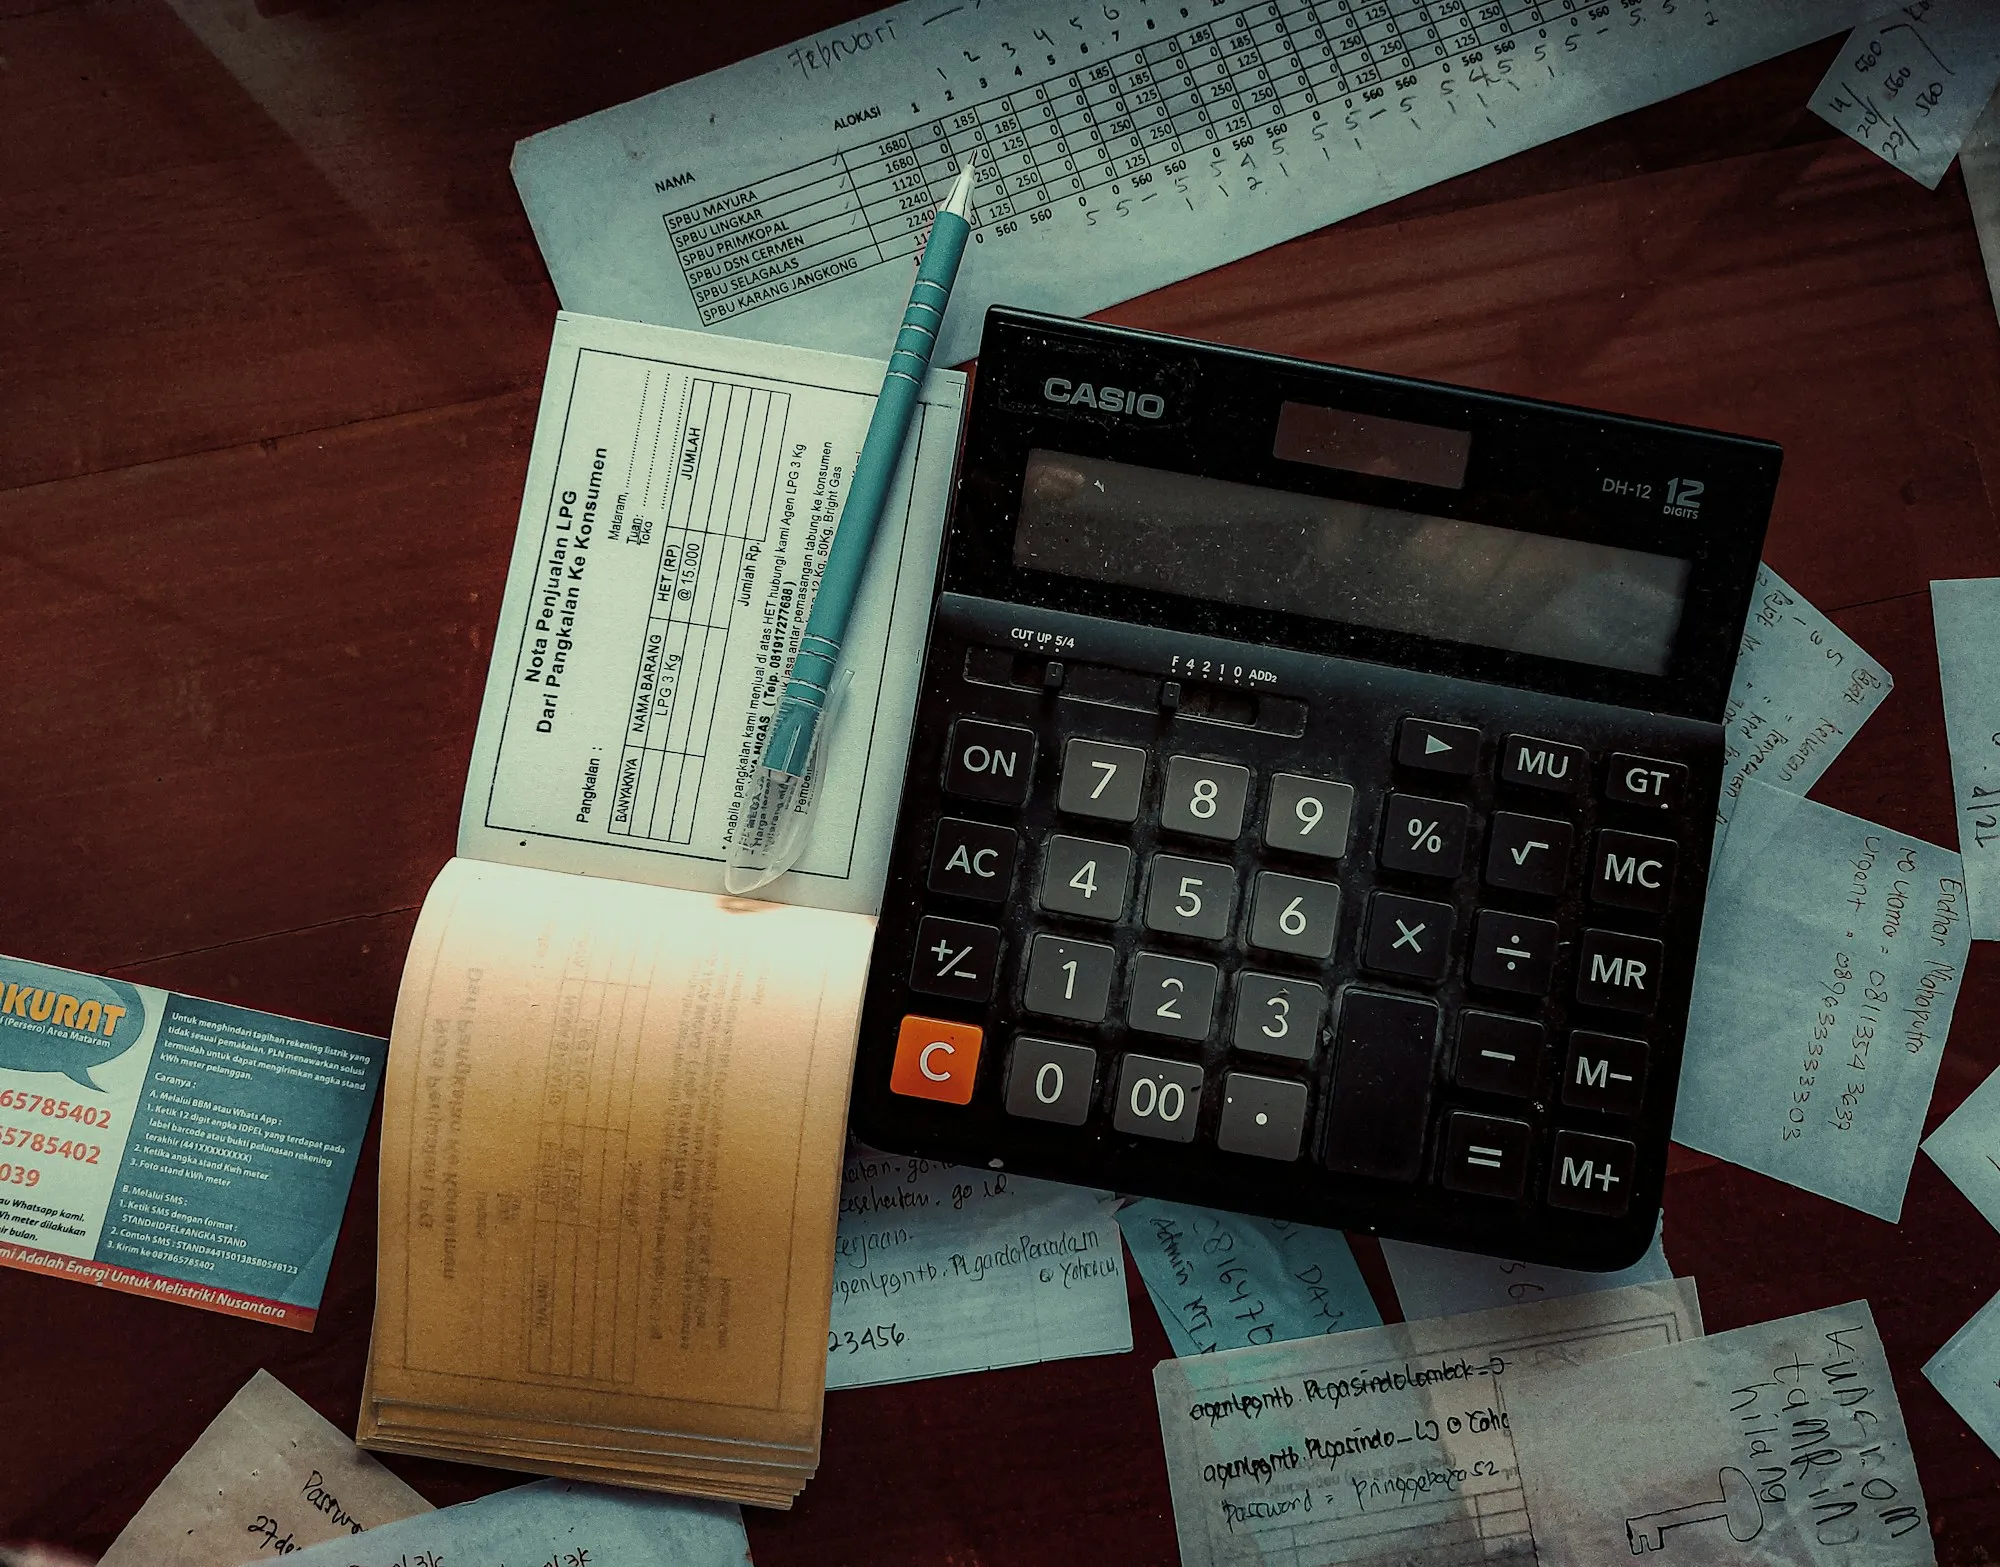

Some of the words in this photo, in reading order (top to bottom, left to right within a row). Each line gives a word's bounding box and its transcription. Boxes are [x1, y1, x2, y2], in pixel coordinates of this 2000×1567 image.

[834, 105, 881, 131] ALOKASI
[953, 112, 975, 129] 185
[654, 171, 696, 193] NAMA
[668, 209, 701, 230] SPBU
[701, 190, 758, 218] MAYURA
[878, 137, 907, 156] 1680
[675, 227, 708, 248] SPBU
[709, 208, 764, 235] LINGKAR
[885, 155, 914, 174] 1680
[682, 245, 715, 266] SPBU
[716, 220, 790, 254] PRIMKOPAL
[891, 173, 921, 192] 1120
[689, 264, 721, 285] SPBU
[723, 253, 750, 272] DSN
[751, 234, 805, 262] CERMEN
[898, 191, 928, 210] 2240
[995, 220, 1018, 237] 560
[1029, 208, 1052, 224] 560
[696, 282, 728, 303] SPBU
[730, 257, 799, 290] SELAGALAS
[905, 209, 935, 228] 2240
[703, 300, 736, 321] SPBU
[737, 281, 790, 309] KARANG
[791, 257, 858, 289] JANGKONG
[1043, 377, 1165, 419] CASIO
[680, 427, 701, 480] JUMLAH
[791, 443, 807, 458] Kg
[812, 441, 832, 496] konsumen
[785, 471, 799, 494] LPG
[828, 466, 842, 488] Gas
[1602, 478, 1652, 499] DH-12
[1666, 477, 1704, 509] 12
[555, 490, 577, 531] LPG
[573, 447, 607, 550] Konsumen
[607, 492, 629, 541] Mataram,
[780, 497, 795, 526] Agen
[810, 499, 822, 512] ke
[822, 490, 838, 523] Bright
[1662, 505, 1698, 519] DIGITS
[638, 521, 653, 545] Toko
[774, 527, 790, 553] kami
[803, 514, 822, 551] tabung
[816, 526, 834, 557] 50Kg,
[567, 556, 586, 580] Ke
[663, 544, 681, 572] (RP)
[680, 543, 700, 584] 15.000
[744, 542, 761, 561] Rp.
[535, 537, 568, 631] Penjualan
[656, 574, 672, 602] HET
[737, 565, 756, 607] Jumlah
[766, 555, 787, 599] hubungi
[793, 554, 813, 624] pemasangan
[762, 600, 776, 625] HET
[544, 587, 580, 687] Pangkalan
[759, 628, 772, 651] atas
[788, 625, 800, 654] antar
[1011, 627, 1035, 640] CUT
[1036, 632, 1052, 643] UP
[1054, 635, 1074, 648] 5/4
[524, 638, 548, 682] Nota
[640, 634, 662, 691] BARANG
[1172, 655, 1179, 667] F
[1185, 658, 1195, 670] 4
[1202, 660, 1211, 672] 2
[1220, 663, 1225, 675] 1
[654, 687, 672, 716] LPG
[663, 654, 682, 671] Kg
[749, 666, 765, 709] menjual
[763, 672, 779, 697] Telp.
[535, 693, 558, 733] Dari
[631, 694, 651, 733] NAMA
[741, 711, 757, 738] kami
[733, 741, 752, 799] pangkalan
[963, 745, 1016, 777] ON
[1090, 761, 1116, 798] 7
[1517, 747, 1568, 778] MU
[575, 758, 600, 823] Pangkalan
[614, 758, 638, 823] BANYAKNYA
[1189, 779, 1218, 818] 8
[1625, 767, 1670, 796] GT
[722, 801, 741, 843] Anabila
[1295, 797, 1323, 834] 9
[1408, 818, 1441, 853] %
[944, 844, 998, 877] AC
[1069, 860, 1097, 898] 4
[1604, 853, 1662, 888] MC
[1175, 877, 1203, 917] 5
[1279, 897, 1306, 935] 6
[1062, 960, 1077, 999] 1
[1590, 954, 1647, 989] MR
[0, 982, 127, 1037] KURAT
[1156, 978, 1183, 1019] 2
[1262, 997, 1289, 1038] 3
[46, 1026, 68, 1038] Area
[69, 1030, 110, 1048] Mataram
[164, 1039, 205, 1055] termudah
[206, 1050, 231, 1060] untuk
[232, 1054, 257, 1067] dapat
[168, 1026, 190, 1037] tidak
[190, 1032, 217, 1043] sesuai
[267, 1047, 285, 1058] PLN
[284, 1053, 339, 1070] menawarkan
[339, 1065, 365, 1076] solusi
[171, 1012, 197, 1025] Untuk
[198, 1019, 252, 1037] menghindari
[252, 1030, 285, 1045] tagihan
[285, 1039, 323, 1055] rekening
[323, 1045, 348, 1058] listrik
[348, 1053, 370, 1065] yang
[154, 1072, 191, 1087] Caranya
[159, 1052, 179, 1064] kWh
[180, 1058, 206, 1069] meter
[205, 1064, 253, 1080] pelanggan.
[919, 1041, 954, 1081] C
[1035, 1062, 1063, 1103] 0
[1130, 1078, 1184, 1121] 00
[191, 1098, 212, 1109] BBM
[212, 1104, 232, 1114] atau
[232, 1107, 258, 1120] Whats
[259, 1113, 277, 1126] App
[0, 1125, 101, 1165] 5785402
[1560, 1156, 1619, 1192] M+
[10, 1215, 40, 1226] meter
[39, 1219, 86, 1237] dilakukan
[12, 1198, 58, 1217] Whatsapp
[58, 1209, 84, 1222] kami.
[9, 1227, 38, 1241] bulan.
[15, 1250, 64, 1270] Adalah
[65, 1260, 110, 1285] Energi
[110, 1269, 152, 1289] Untuk
[152, 1279, 216, 1302] Melistriki
[215, 1292, 286, 1318] Nusantara
